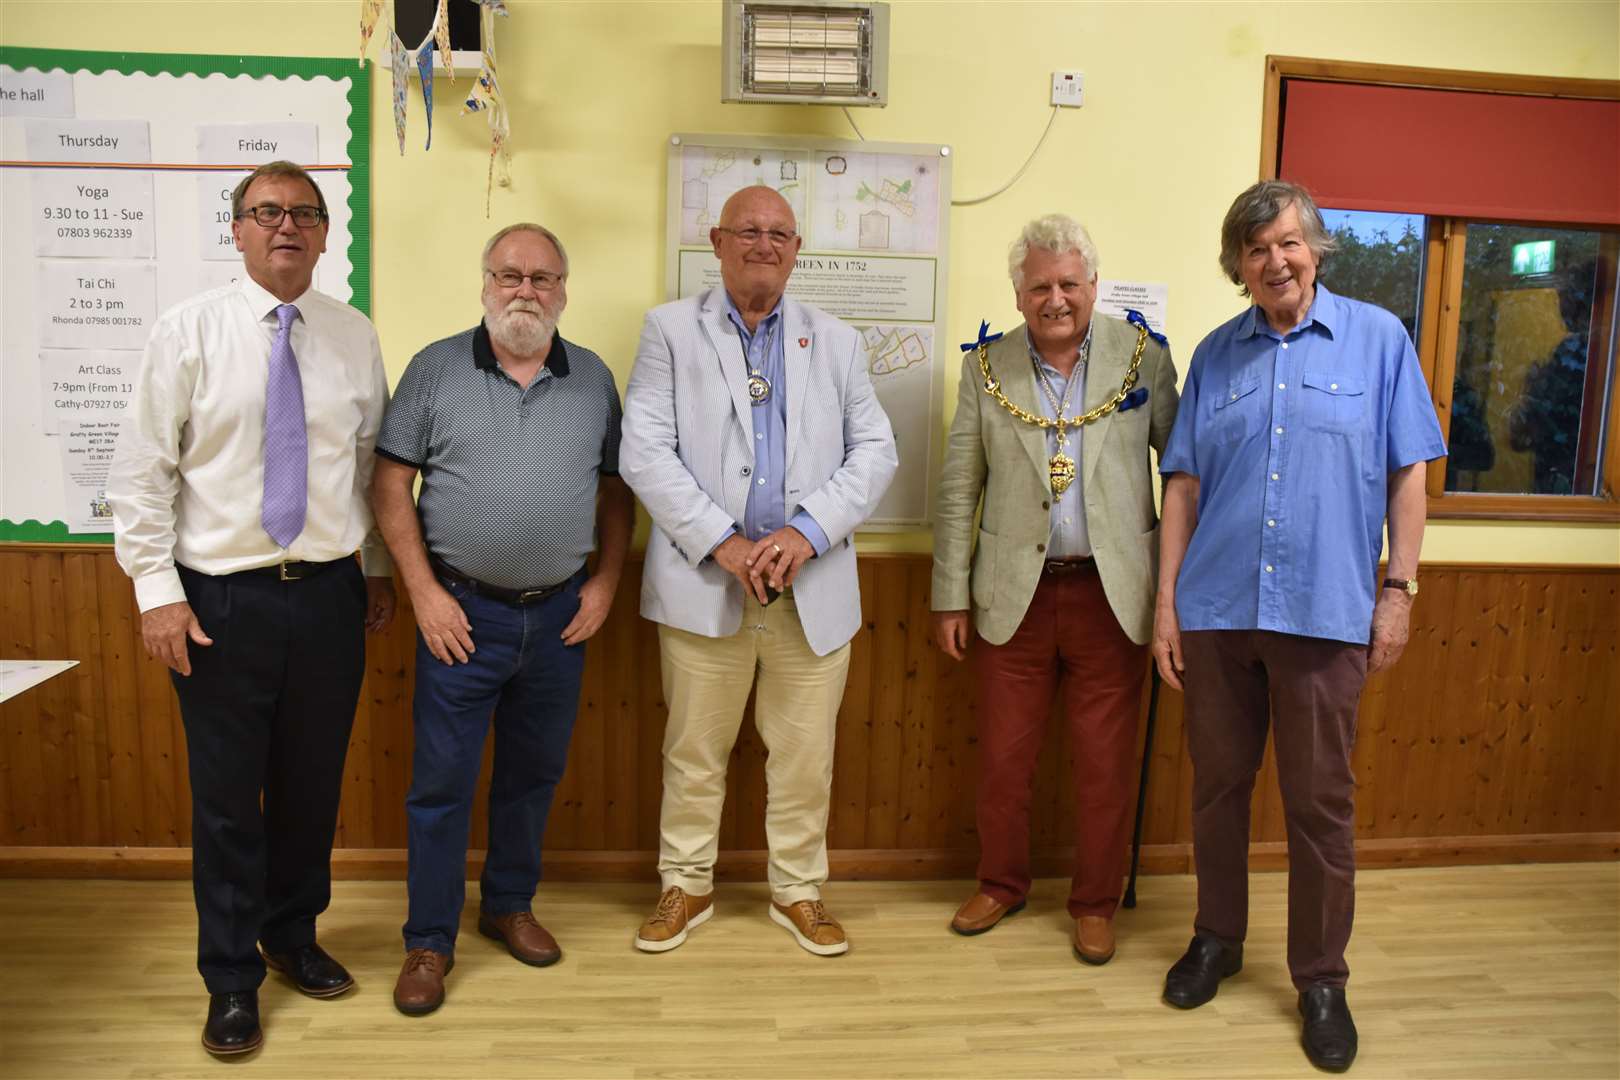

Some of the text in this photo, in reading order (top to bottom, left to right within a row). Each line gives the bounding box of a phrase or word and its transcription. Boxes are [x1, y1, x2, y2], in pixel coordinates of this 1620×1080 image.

[0, 87, 45, 101] he hall
[58, 134, 119, 150] Thursday
[238, 139, 278, 153] Friday
[76, 185, 109, 200] Yoga
[43, 207, 72, 219] 9.30
[75, 208, 89, 220] to
[93, 208, 109, 220] 11
[121, 208, 144, 220] Sue
[57, 227, 133, 239] 07803 962339
[795, 259, 867, 271] REEN IN 1752
[76, 278, 115, 289] Tai Chi
[69, 297, 124, 311] 2 to 3 pm
[52, 316, 83, 325] Rhonda
[78, 364, 122, 375] Art Class
[52, 382, 86, 394] 7-9pm
[88, 382, 118, 394] (From
